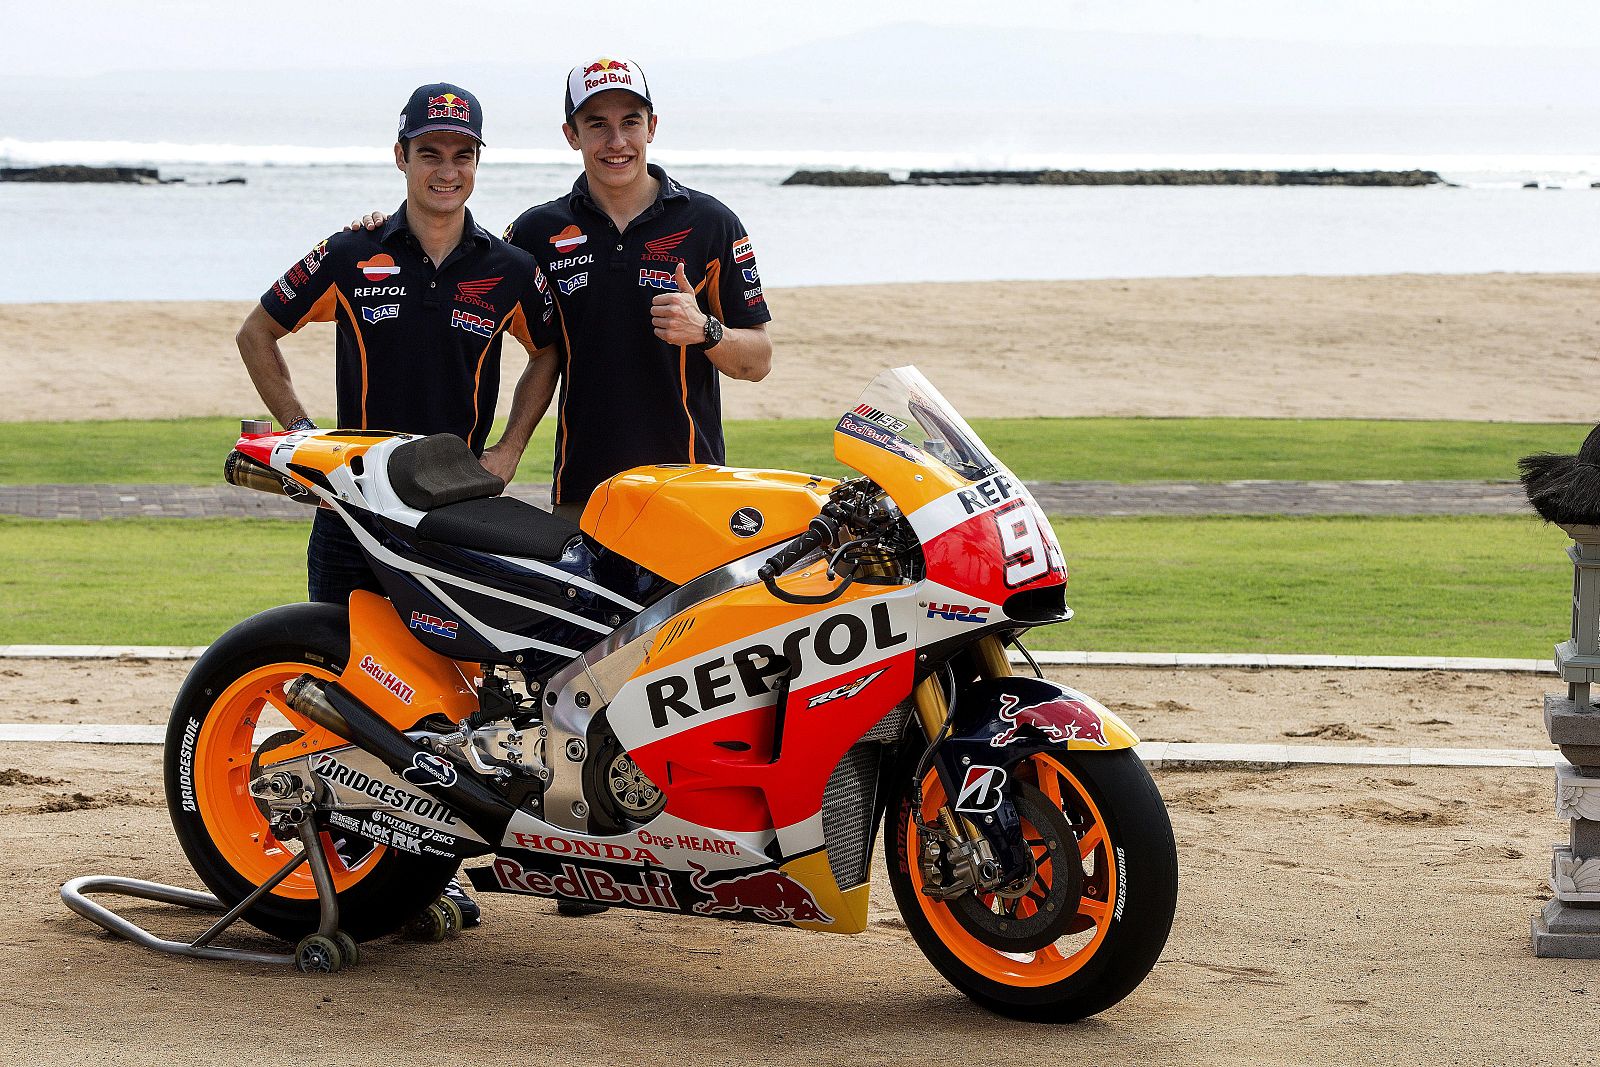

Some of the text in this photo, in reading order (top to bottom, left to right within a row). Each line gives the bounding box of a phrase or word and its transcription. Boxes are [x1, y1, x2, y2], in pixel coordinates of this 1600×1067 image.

[584, 73, 632, 91] Red Bull
[428, 107, 470, 122] Red Bull
[640, 253, 687, 266] HONDA
[735, 243, 753, 257] REP
[304, 251, 320, 275] Bull
[550, 254, 595, 271] REPSOL
[354, 286, 407, 298] REPSOL
[567, 275, 586, 291] GAS
[373, 306, 397, 320] GAS
[454, 294, 496, 313] HONDA
[451, 308, 495, 338] HRC
[840, 417, 891, 444] Red Bull
[956, 474, 1013, 515] REP
[732, 524, 757, 533] HONDA
[926, 601, 991, 623] HRC
[410, 610, 459, 640] HRC
[645, 601, 908, 729] REPSOL
[360, 655, 414, 704] Satu HATI.
[177, 716, 200, 812] BRIDGESTONE
[417, 759, 448, 783] TERMIGNONI
[361, 819, 391, 841] NGK
[382, 813, 420, 836] YUTAKA
[391, 830, 423, 853] RK
[511, 832, 664, 865] HONDA
[637, 829, 741, 856] One HEART.
[492, 856, 681, 911] Red Bull
[1113, 846, 1127, 923] BRIDGESTONE
